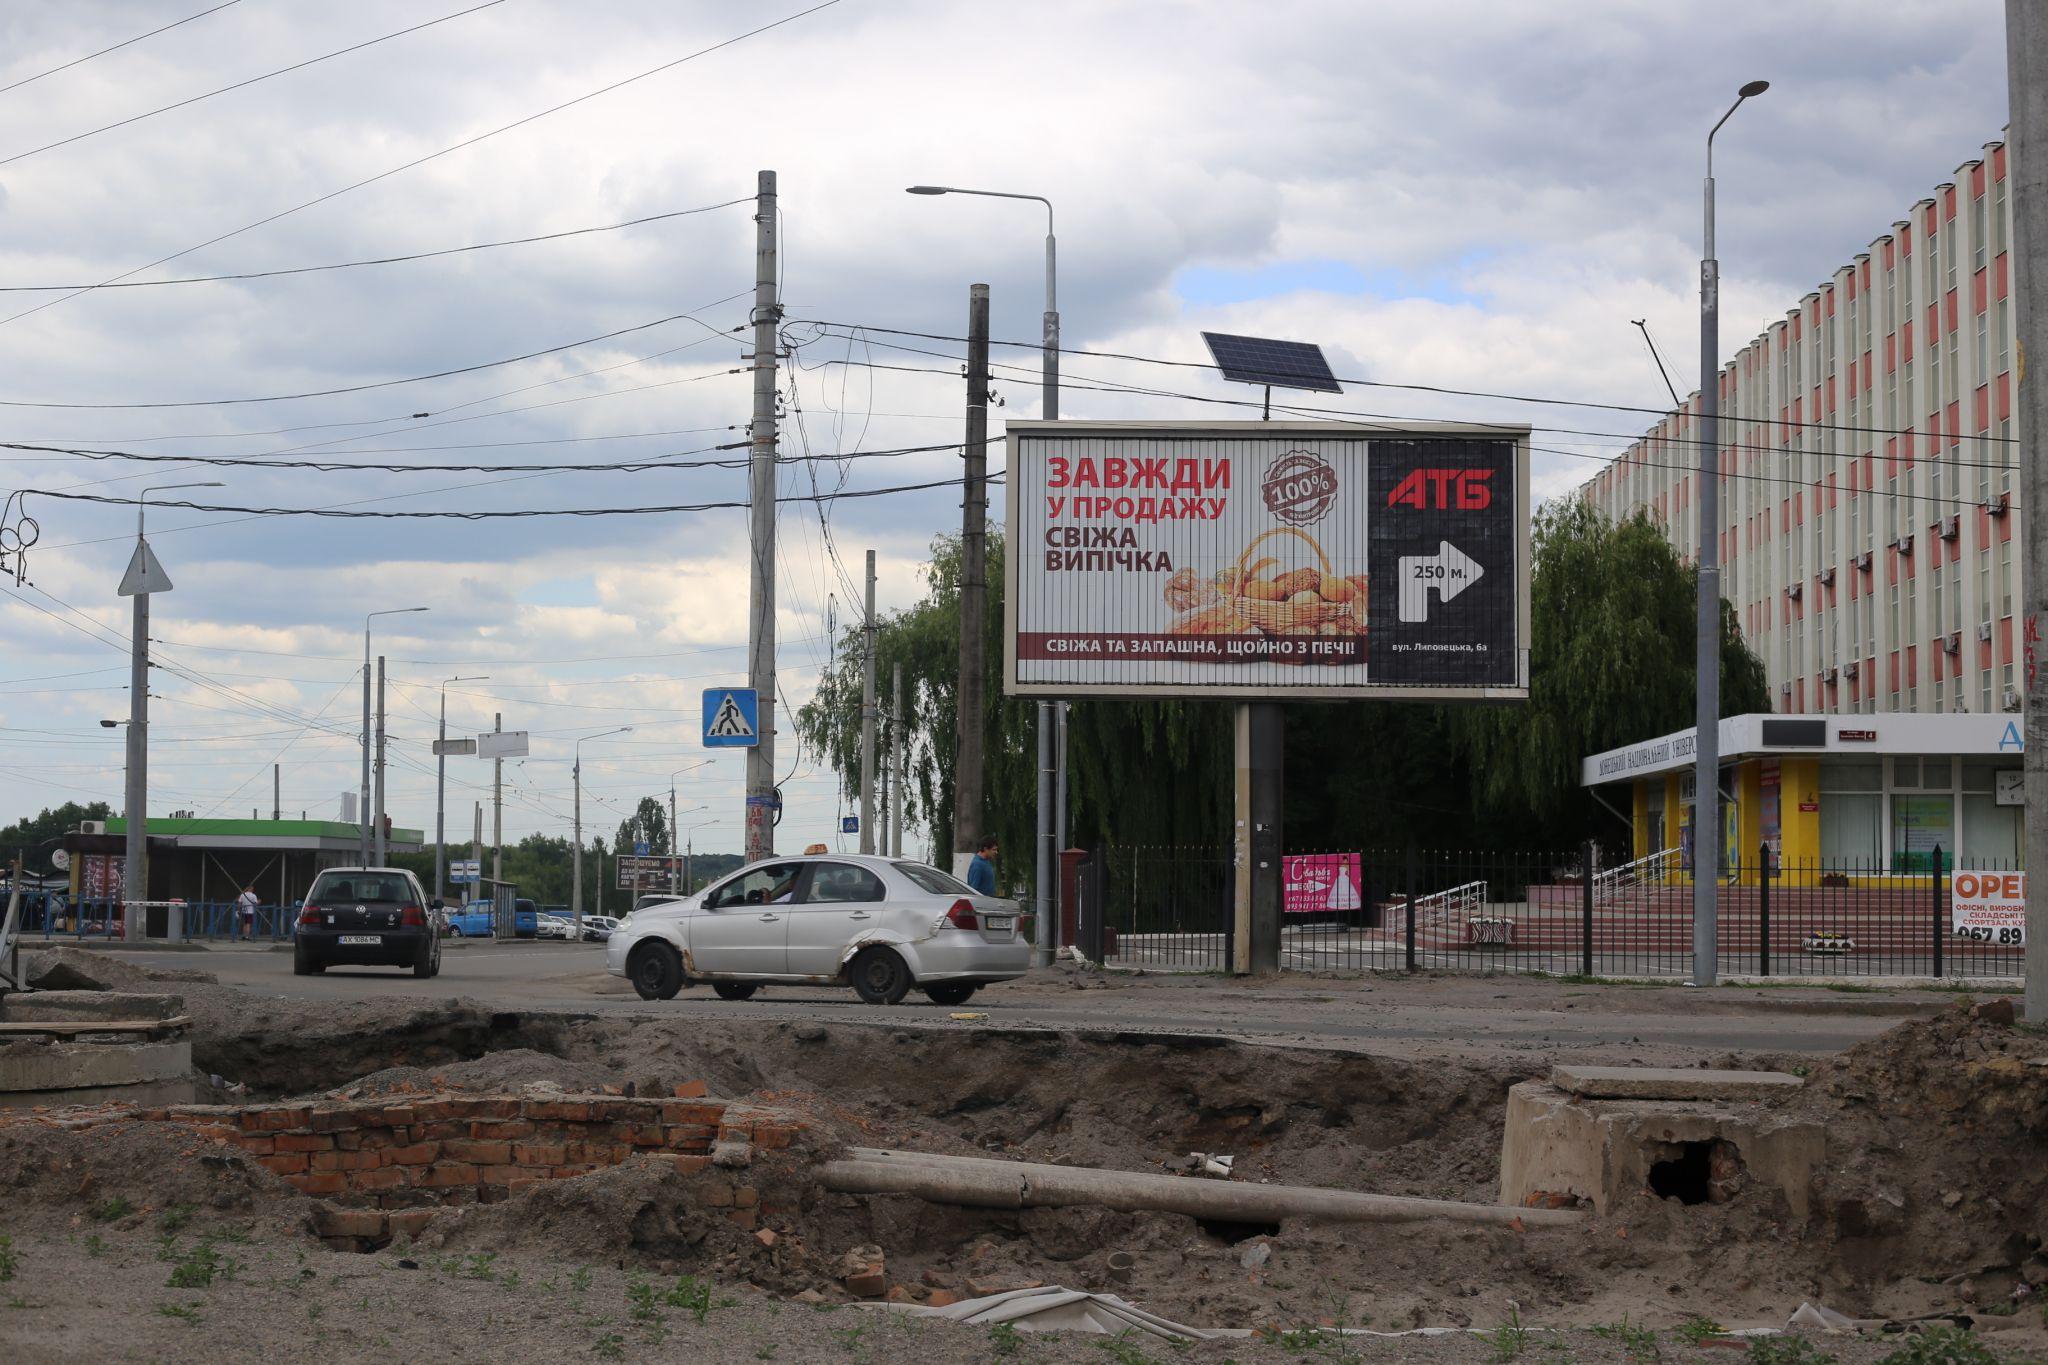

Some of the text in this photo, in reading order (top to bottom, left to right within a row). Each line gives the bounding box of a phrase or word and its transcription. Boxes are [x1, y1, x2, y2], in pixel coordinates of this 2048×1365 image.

[1048, 457, 1231, 496] ЗАВЖДИ
[1271, 472, 1330, 504] 100%
[1388, 468, 1495, 509] АТБ
[1047, 496, 1226, 524] У ПРОДАЖУ
[1045, 526, 1138, 548] СВІЖА
[1046, 550, 1173, 572] ВИПІЧКА
[1414, 565, 1468, 579] 250 м.
[1046, 639, 1355, 656] СВІЖА ТА ЗАПАШНА, ЩОЙНО З ПЕЧІ!
[1392, 644, 1412, 652] вул.
[1414, 642, 1474, 652] Липовецька,
[1627, 740, 1670, 769] НАЦІОНАЛЬНИЙ
[1956, 904, 1988, 912] ОФІСНІ,
[1958, 926, 2022, 944] 067 89
